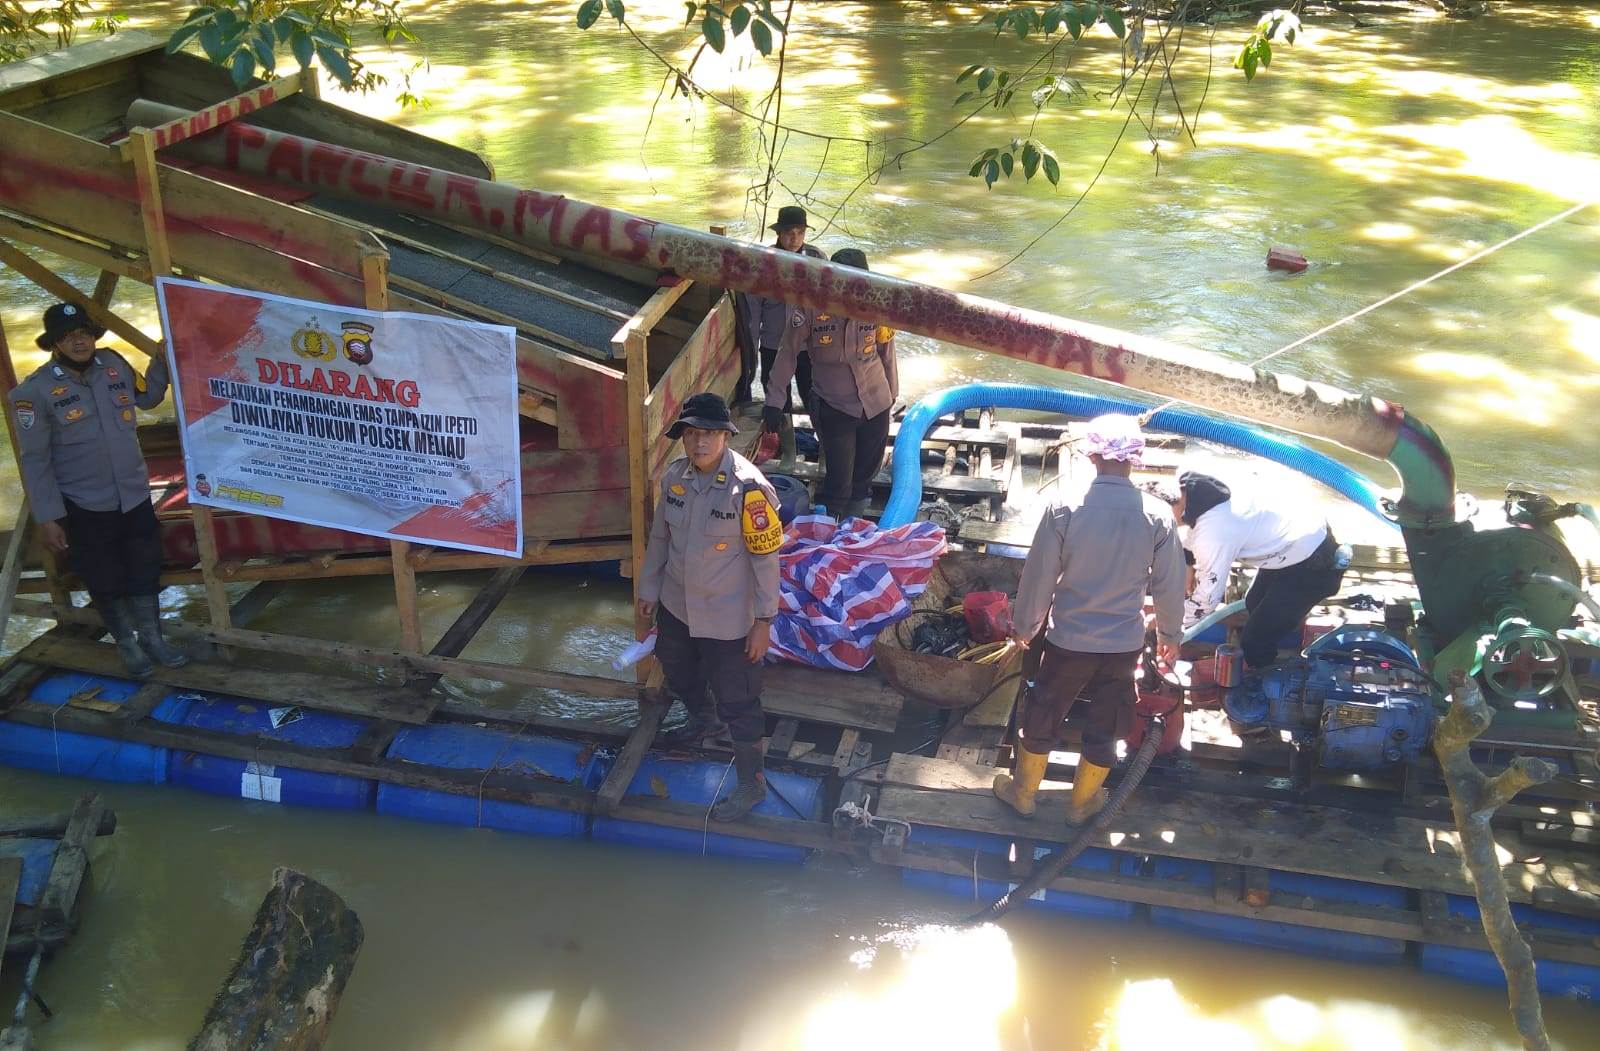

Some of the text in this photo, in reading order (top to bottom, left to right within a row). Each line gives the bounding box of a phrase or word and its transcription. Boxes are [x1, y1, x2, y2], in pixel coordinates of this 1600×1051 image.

[256, 357, 421, 408] DILARANG
[209, 379, 477, 436] MELAKUKAN PENAMBANGAN EMAS TANPA IZIN (PETI)
[223, 425, 260, 437] MELANGGAR
[261, 431, 279, 441] PASAL
[292, 437, 308, 446] ATAU
[309, 440, 328, 449] PASAL
[341, 445, 394, 460] UNDANG-UNDANG
[403, 455, 428, 465] NOMOR
[428, 458, 433, 466] 3
[433, 459, 455, 468] TAHUN
[230, 401, 465, 460] DIWILAYAH HUKUM POLSEK MELIAU
[243, 438, 270, 449] TENTANG
[270, 443, 307, 455] PERUBAHAN
[325, 452, 376, 467] UNDANG-UNDANG
[385, 463, 408, 472] NOMOR
[415, 466, 437, 475] TAHUN
[438, 470, 453, 478] 2009
[251, 458, 276, 468] DENGAN
[277, 462, 306, 474] ANCAMAN
[330, 471, 358, 482] PENJARA
[359, 477, 379, 487] PALING
[381, 481, 399, 489] LAMA
[426, 487, 447, 496] TAHUN
[253, 469, 273, 477] DENDA
[274, 472, 296, 481] PALING
[279, 454, 307, 465] TENTANG
[309, 459, 334, 469] MINERAL
[336, 463, 349, 471] DAN
[349, 466, 381, 477] BATUBARA
[710, 508, 735, 520] POLRI
